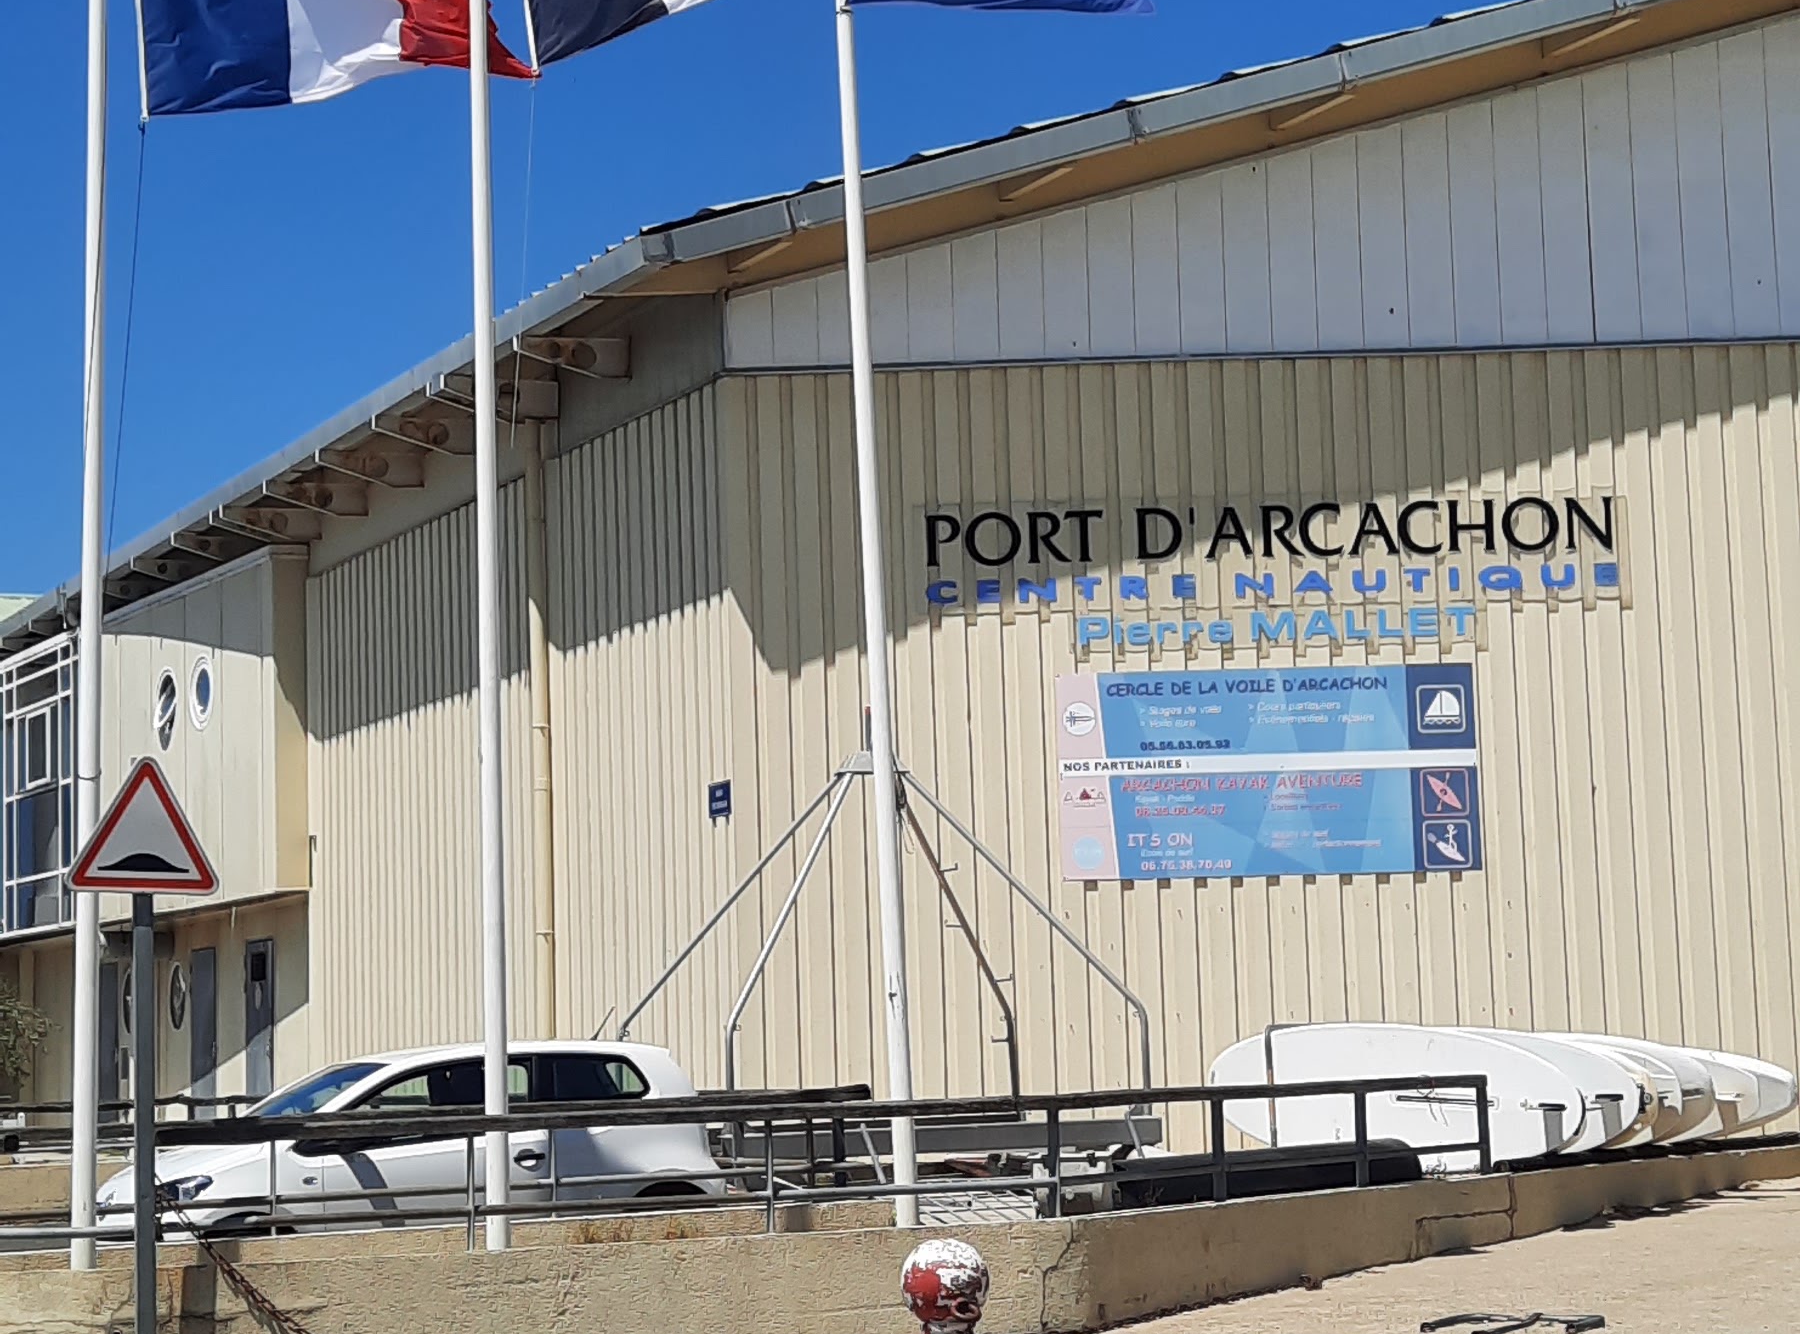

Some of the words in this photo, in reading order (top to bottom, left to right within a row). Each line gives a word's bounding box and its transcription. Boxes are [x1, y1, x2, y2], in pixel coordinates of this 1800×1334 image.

[925, 509, 1104, 567] PORT
[1134, 496, 1614, 560] D'ARCACHON
[926, 573, 1197, 603] CENTRE
[1235, 563, 1620, 599] NAUTIQUE
[1079, 615, 1234, 646] Pierre
[1251, 606, 1476, 642] MALLET
[1106, 682, 1164, 697] CERCLE
[1171, 681, 1191, 695] DE
[1198, 681, 1218, 695] LA
[1225, 678, 1276, 694] VOILE
[1282, 676, 1388, 692] D'ARCACHON
[1063, 762, 1090, 772] NOS
[1094, 759, 1182, 771] PARTENAIRES
[1120, 777, 1211, 792] ARCACHON
[1216, 774, 1270, 791] KAYAK
[1276, 772, 1363, 789] AVENTURE
[1167, 831, 1194, 847] ON
